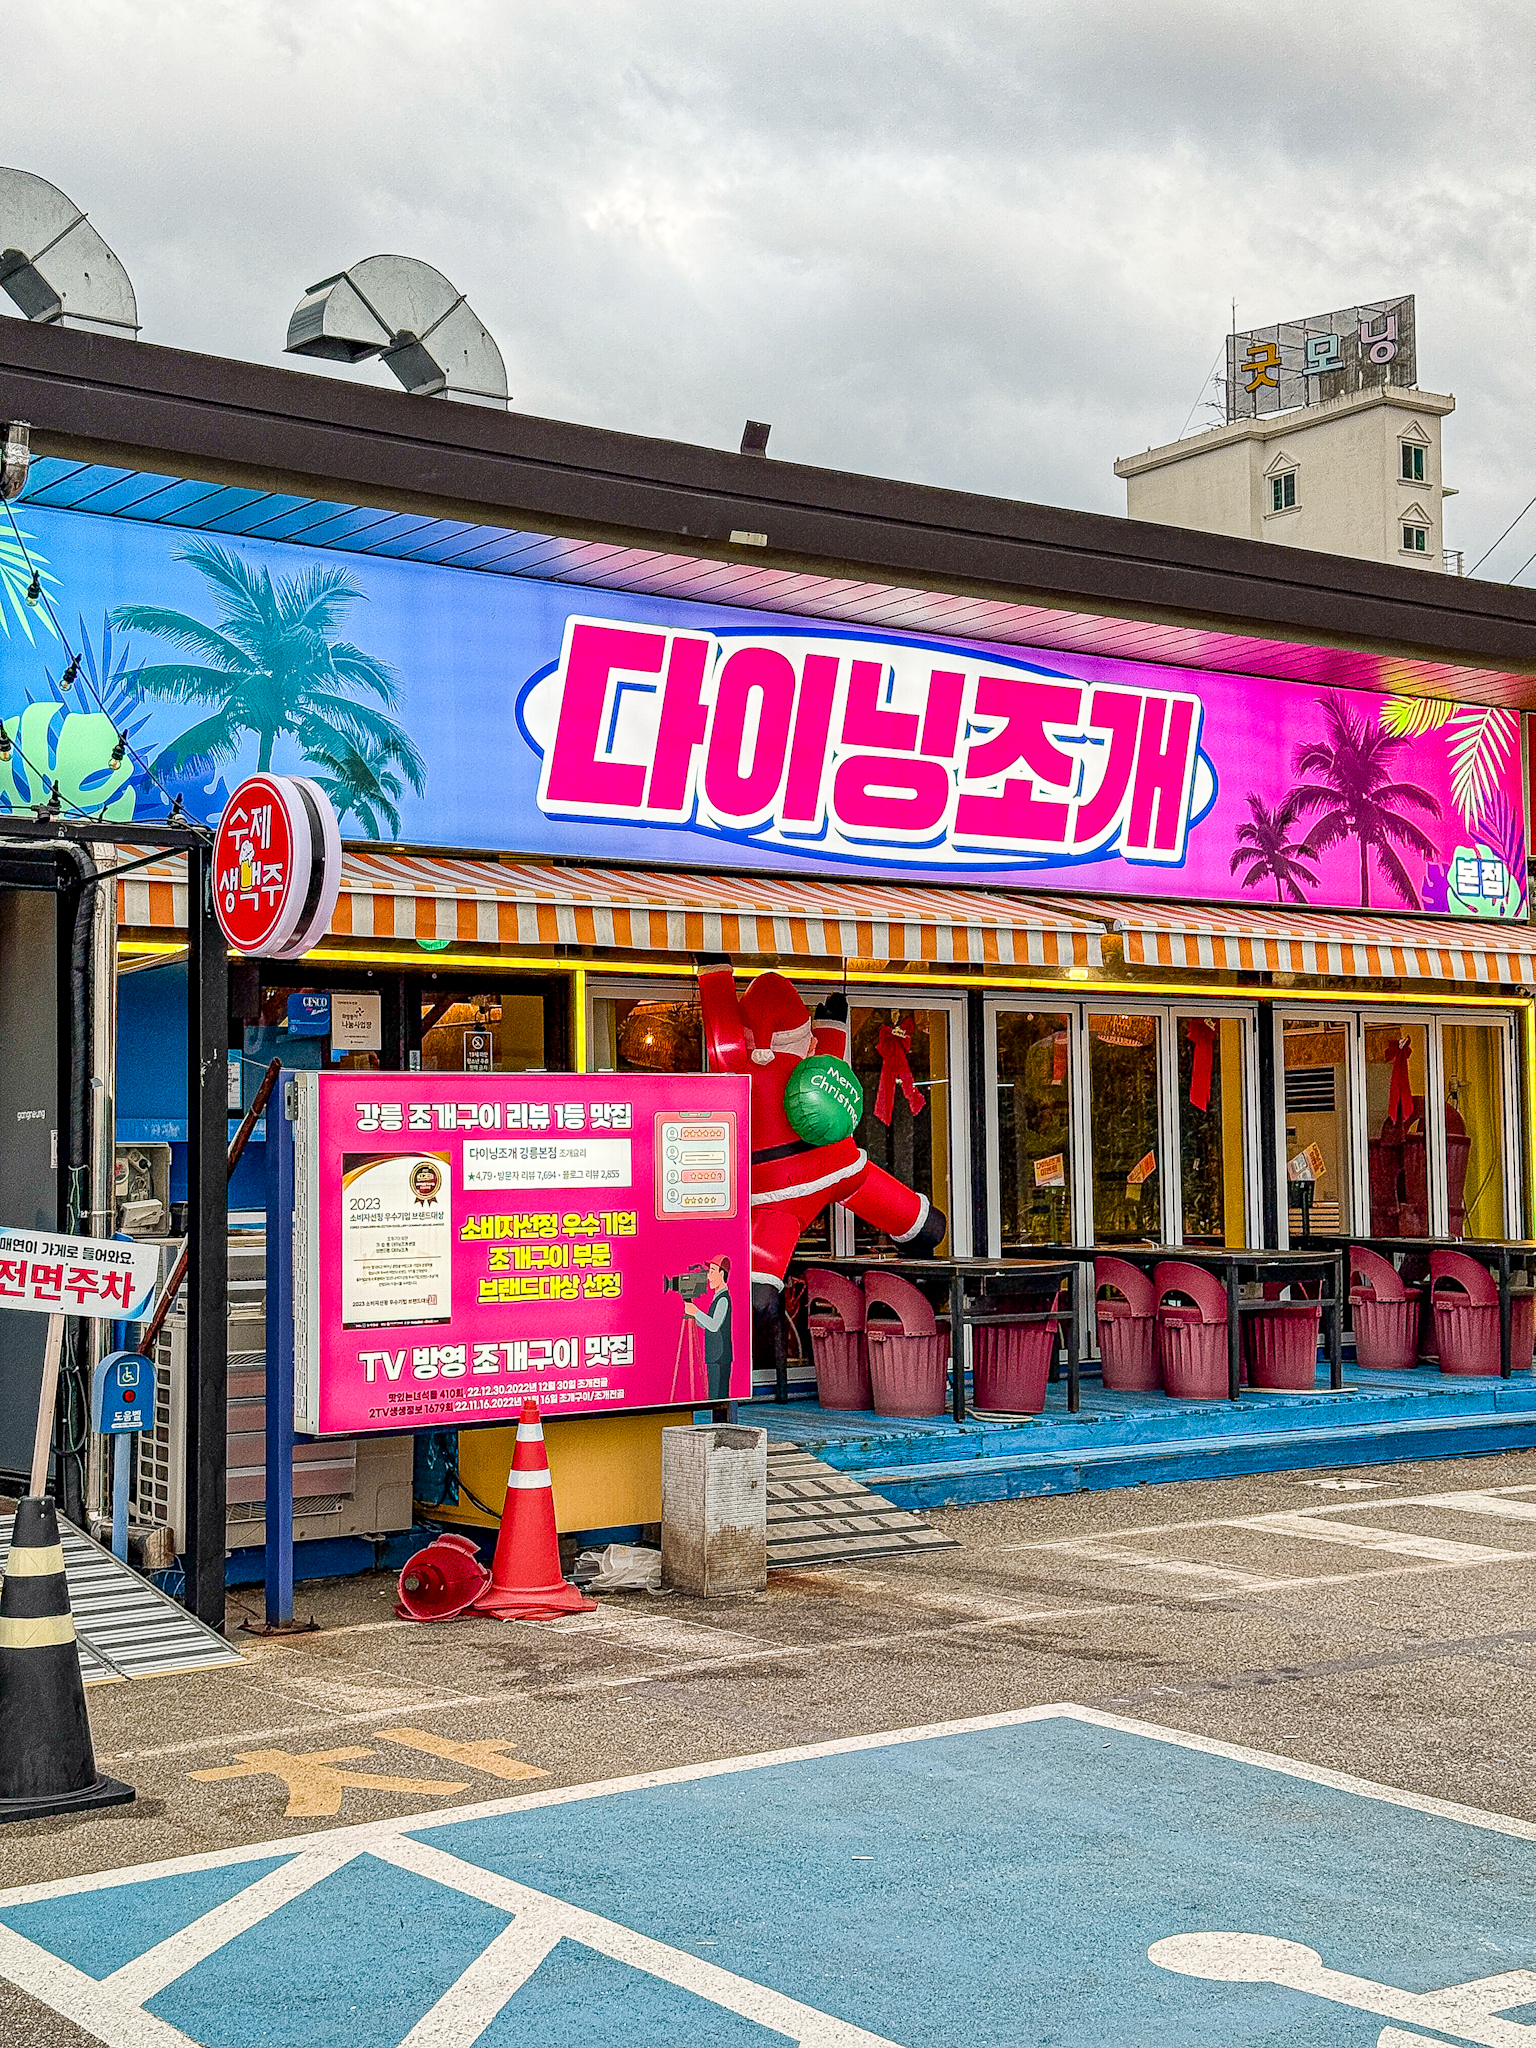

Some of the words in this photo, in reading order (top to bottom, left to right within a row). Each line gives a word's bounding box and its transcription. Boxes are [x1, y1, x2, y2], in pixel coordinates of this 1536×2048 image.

[545, 622, 1197, 852] 다이닝조개
[227, 804, 272, 851] 수제
[219, 860, 283, 914] 생맥주
[1456, 857, 1505, 898] 본점
[302, 996, 328, 1007] CESCO
[827, 1066, 861, 1104] Merry
[355, 1102, 404, 1131] 강릉
[407, 1102, 502, 1131] 조개구이
[505, 1102, 551, 1130] 리뷰
[553, 1102, 586, 1130] 1등
[589, 1102, 633, 1130] 맛집
[469, 1146, 518, 1161] 다이닝조개
[519, 1146, 557, 1160] 강릉본점
[559, 1148, 587, 1158] 조개요리
[521, 1170, 536, 1181] 리뷰
[585, 1169, 599, 1180] 리뷰
[600, 1169, 620, 1180] 2,855
[349, 1197, 381, 1211] 2023
[349, 1212, 384, 1222] 소비자선정
[384, 1211, 411, 1221] 우수기업
[411, 1210, 445, 1220] 브랜드대상
[460, 1213, 559, 1241] 소비자선정
[561, 1211, 638, 1238] 우수기업
[0, 1237, 37, 1254] 매연이
[41, 1242, 79, 1259] 가게로
[82, 1246, 136, 1265] 들어와요.
[488, 1243, 569, 1271] 조개구이
[572, 1242, 611, 1268] 부문
[0, 1259, 136, 1309] 전면주차
[478, 1273, 581, 1303] 브랜드대상
[582, 1271, 622, 1299] 선정
[358, 1350, 407, 1382] TV
[411, 1343, 467, 1380] 방영
[471, 1336, 579, 1375] 조개구이
[584, 1334, 634, 1368] 맛집
[538, 1380, 556, 1392] 12월
[556, 1379, 576, 1391] 30일
[577, 1377, 608, 1389] 조개전골
[540, 1393, 559, 1405] 16일
[112, 1409, 142, 1422] 도움벨
